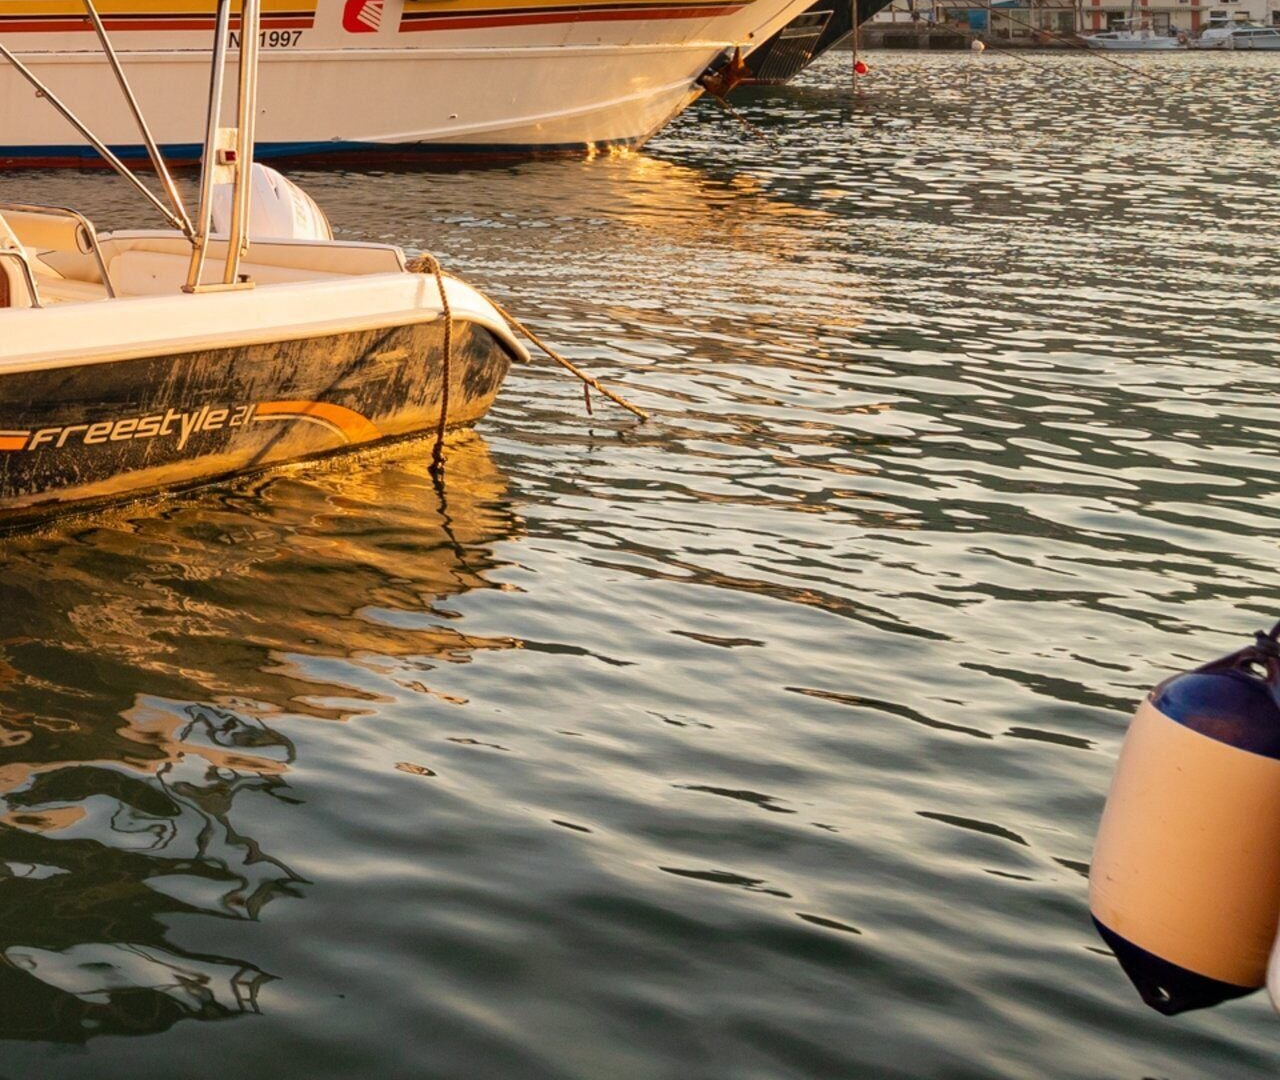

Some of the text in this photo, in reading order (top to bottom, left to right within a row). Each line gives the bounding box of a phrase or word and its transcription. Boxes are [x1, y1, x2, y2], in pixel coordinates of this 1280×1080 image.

[258, 30, 303, 48] 1997
[27, 404, 256, 451] Freestyle 21
